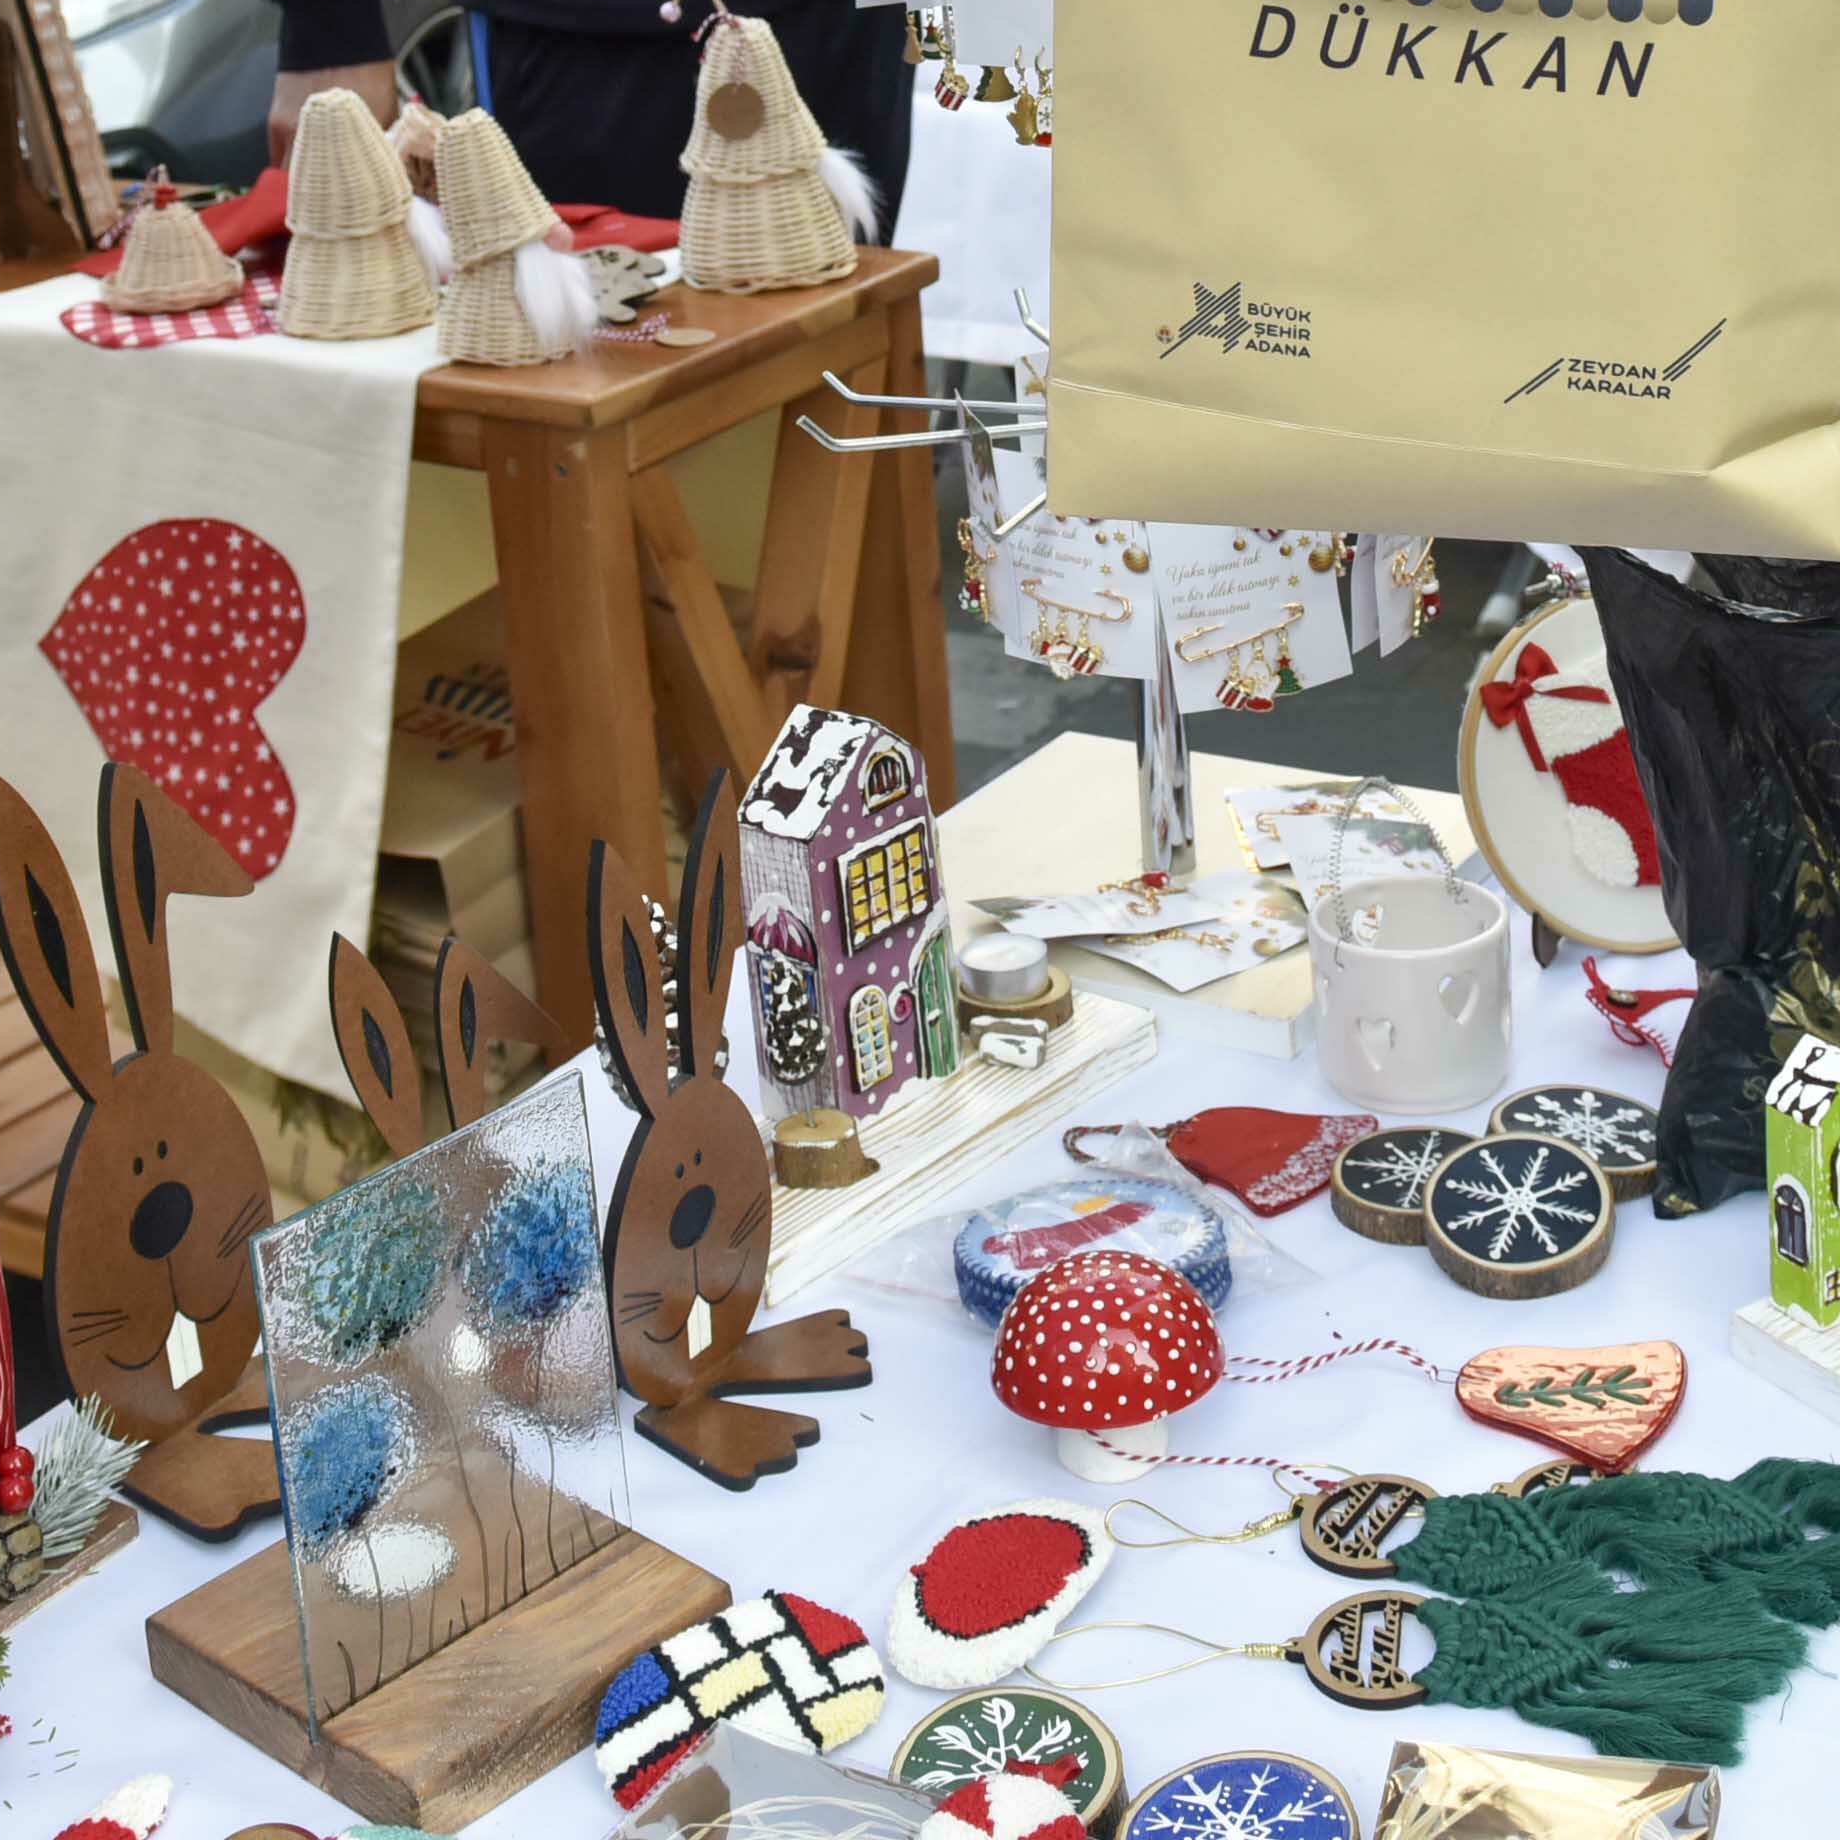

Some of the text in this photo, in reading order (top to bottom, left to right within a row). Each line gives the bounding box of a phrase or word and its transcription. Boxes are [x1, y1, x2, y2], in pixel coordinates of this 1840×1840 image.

[1249, 3, 1655, 98] DÜKKAN
[1247, 302, 1311, 323] BÜYÜK
[1254, 322, 1311, 342] ŞEHİR
[1244, 339, 1311, 359] ADANA
[1567, 358, 1657, 380] ZEYDAN
[1567, 376, 1671, 400] KARALAR
